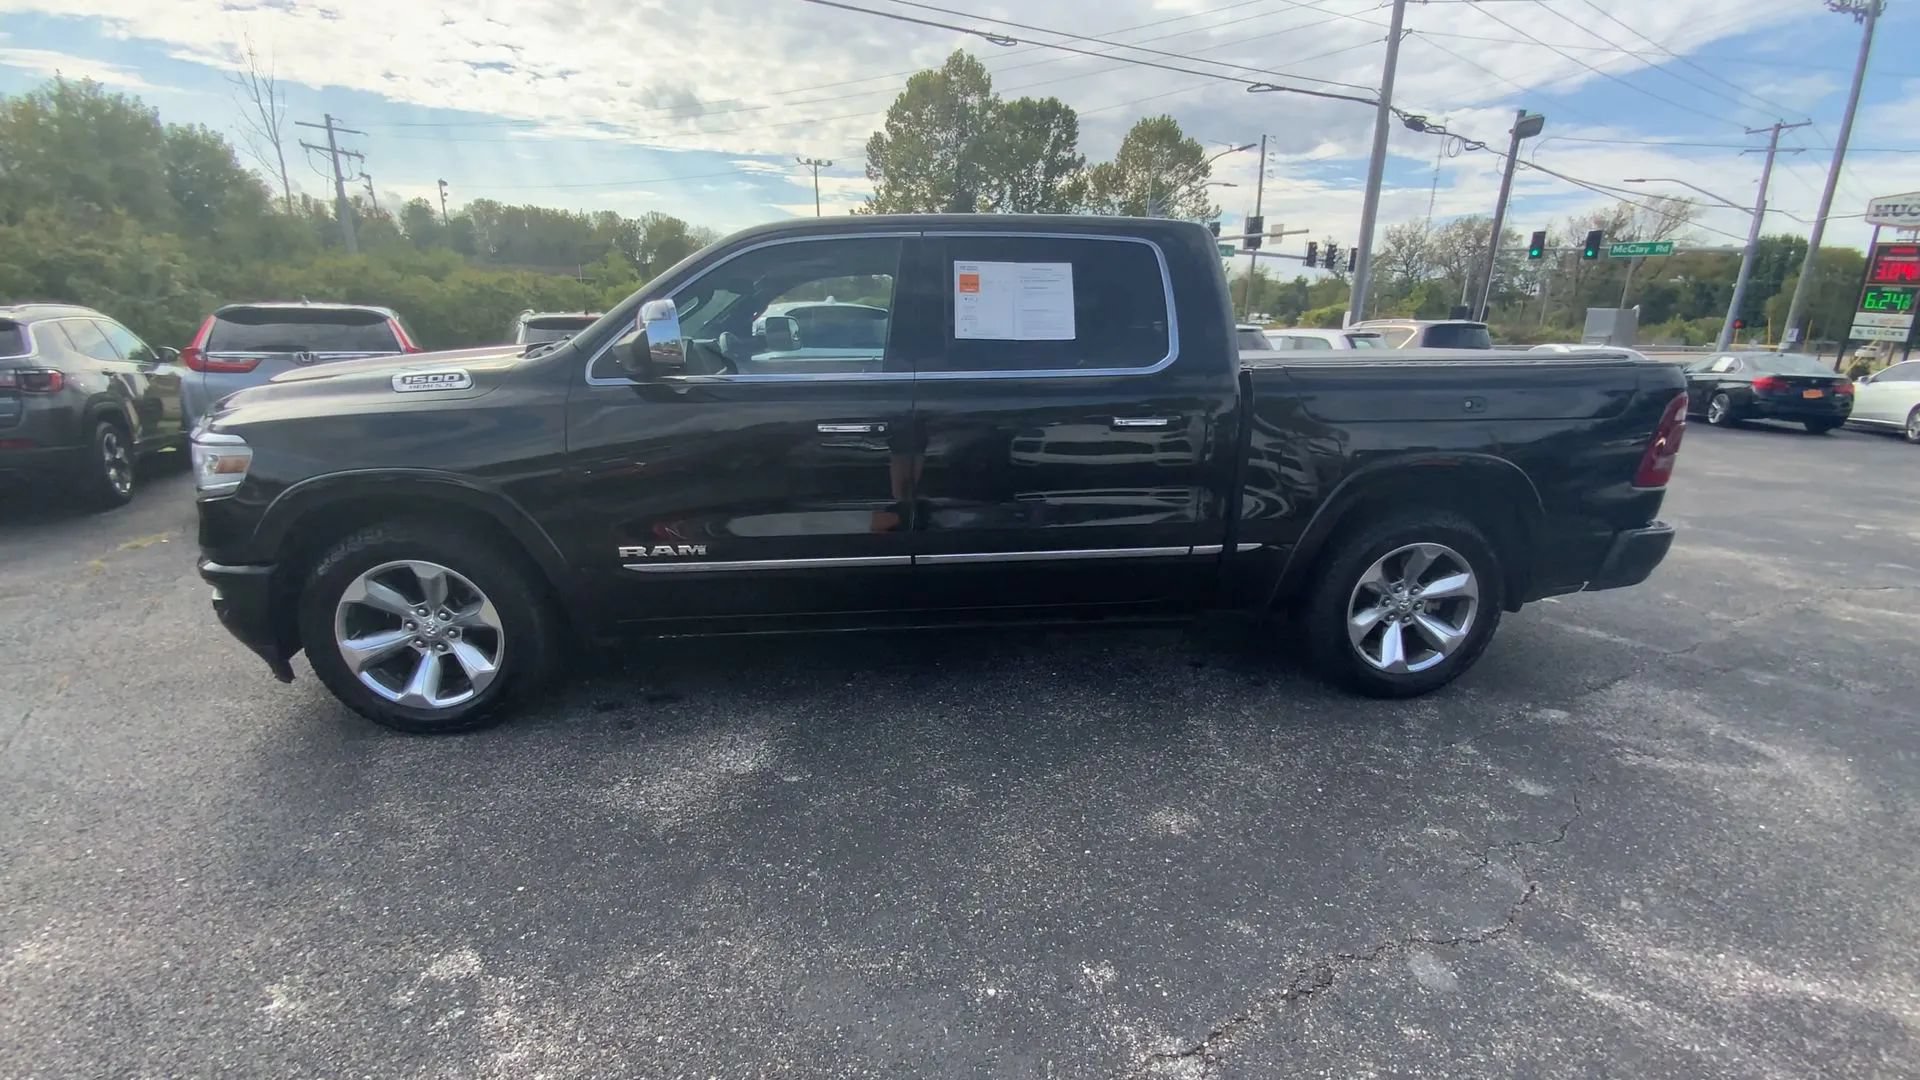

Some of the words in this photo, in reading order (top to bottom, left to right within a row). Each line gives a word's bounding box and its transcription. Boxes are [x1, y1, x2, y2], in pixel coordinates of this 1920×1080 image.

[1612, 244, 1649, 254] McClay
[1655, 244, 1669, 253] Rd
[405, 373, 460, 385] 1500
[618, 544, 707, 557] RAM
